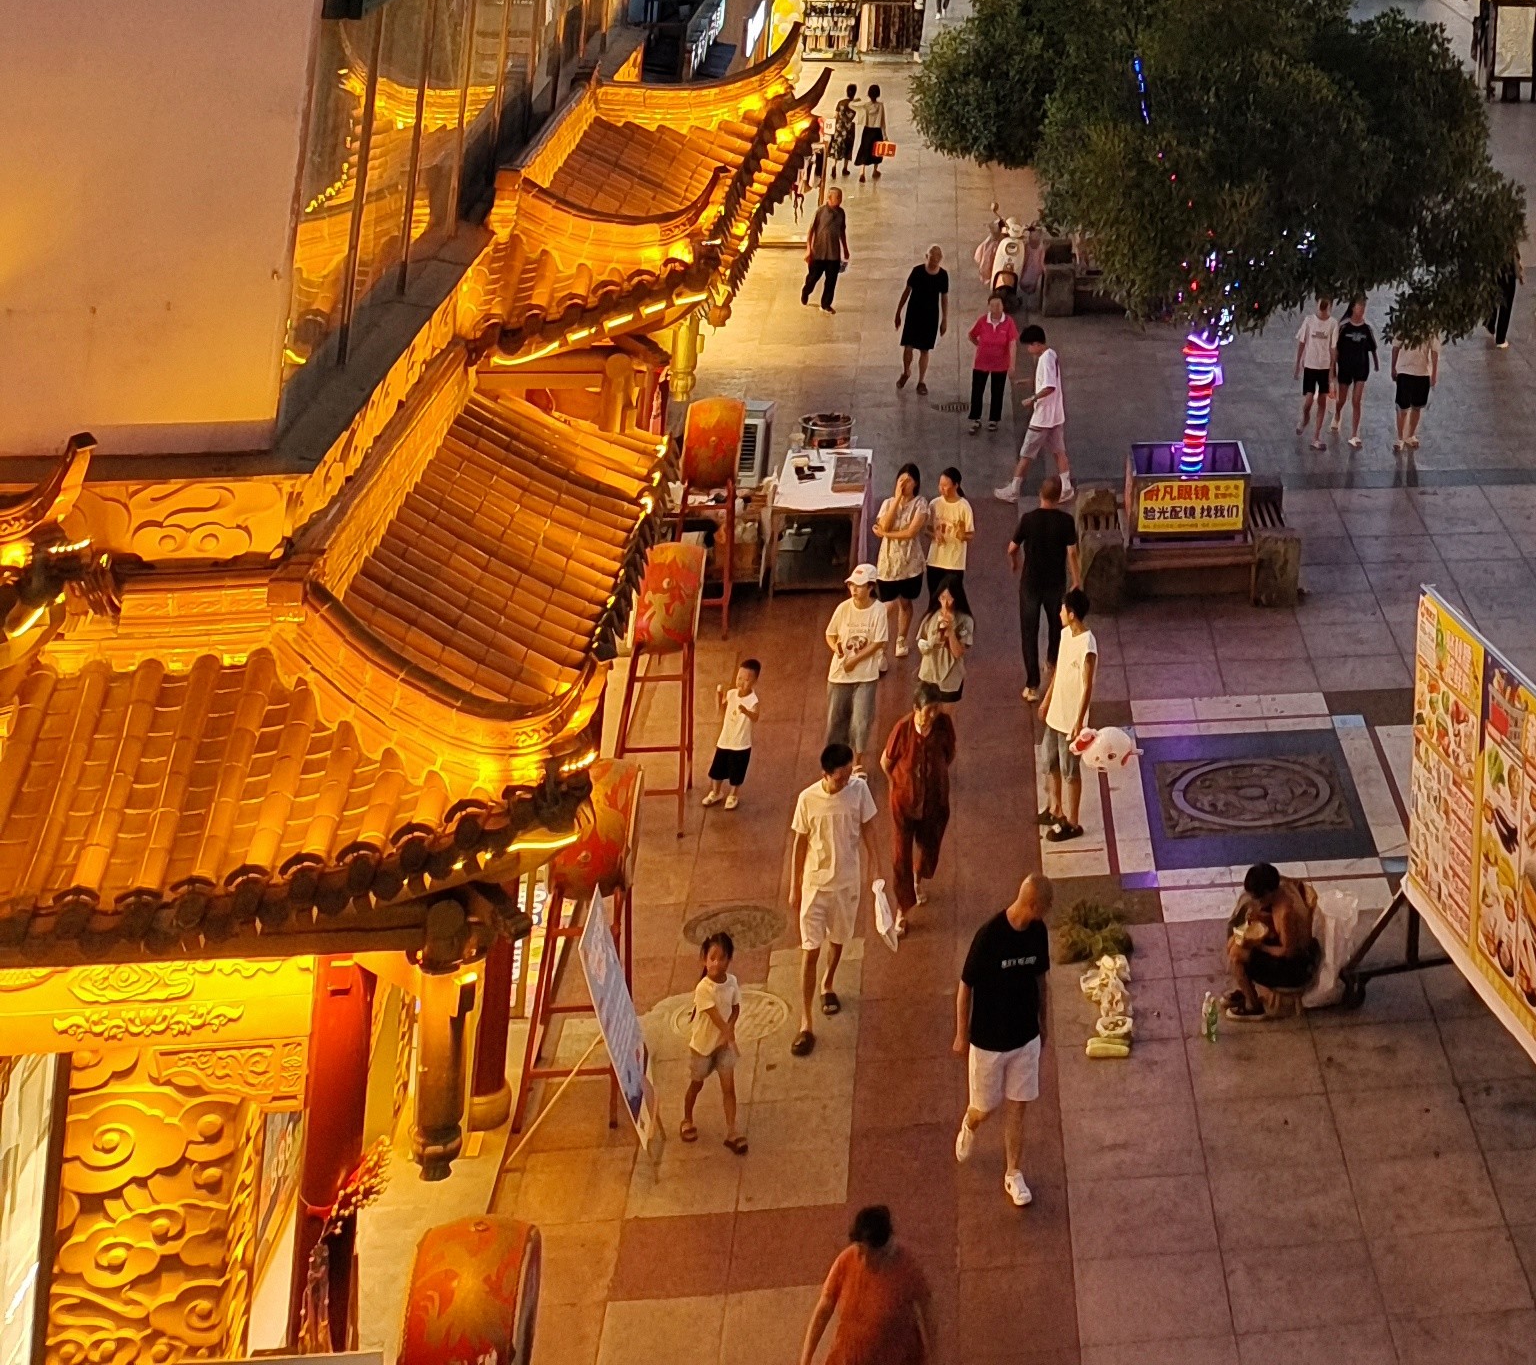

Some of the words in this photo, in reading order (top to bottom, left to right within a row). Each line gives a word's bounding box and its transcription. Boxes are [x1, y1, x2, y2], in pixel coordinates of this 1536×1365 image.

[1144, 485, 1211, 501] 耐凡眼镜
[1143, 506, 1196, 520] 验光配镜
[1200, 505, 1239, 518] 找我们
